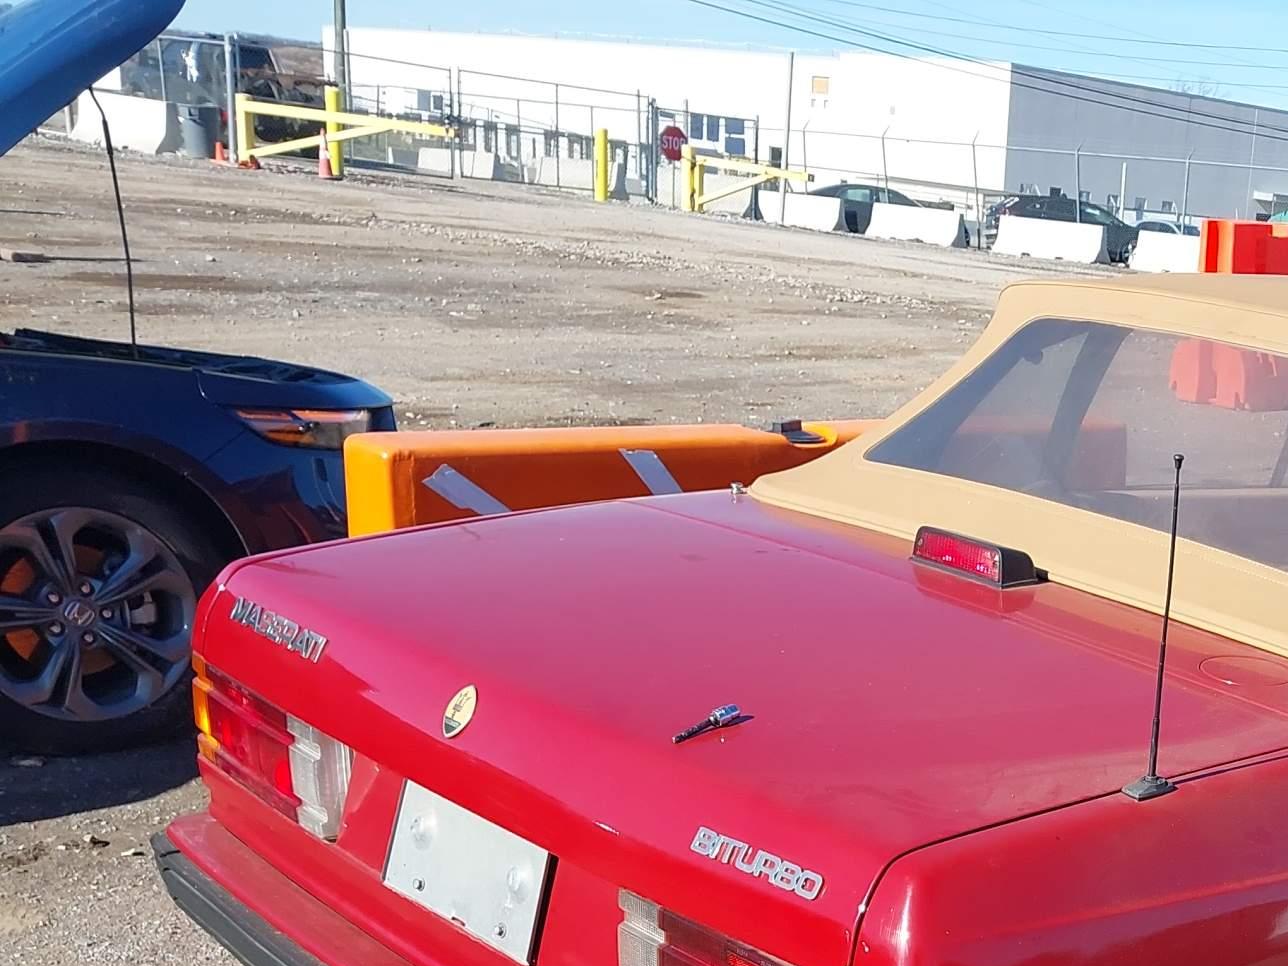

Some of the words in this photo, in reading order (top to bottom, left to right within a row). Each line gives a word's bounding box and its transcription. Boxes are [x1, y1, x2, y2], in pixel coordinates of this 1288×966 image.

[663, 136, 685, 150] STOP
[230, 597, 329, 663] MASERATI
[690, 826, 824, 902] BITURBO
